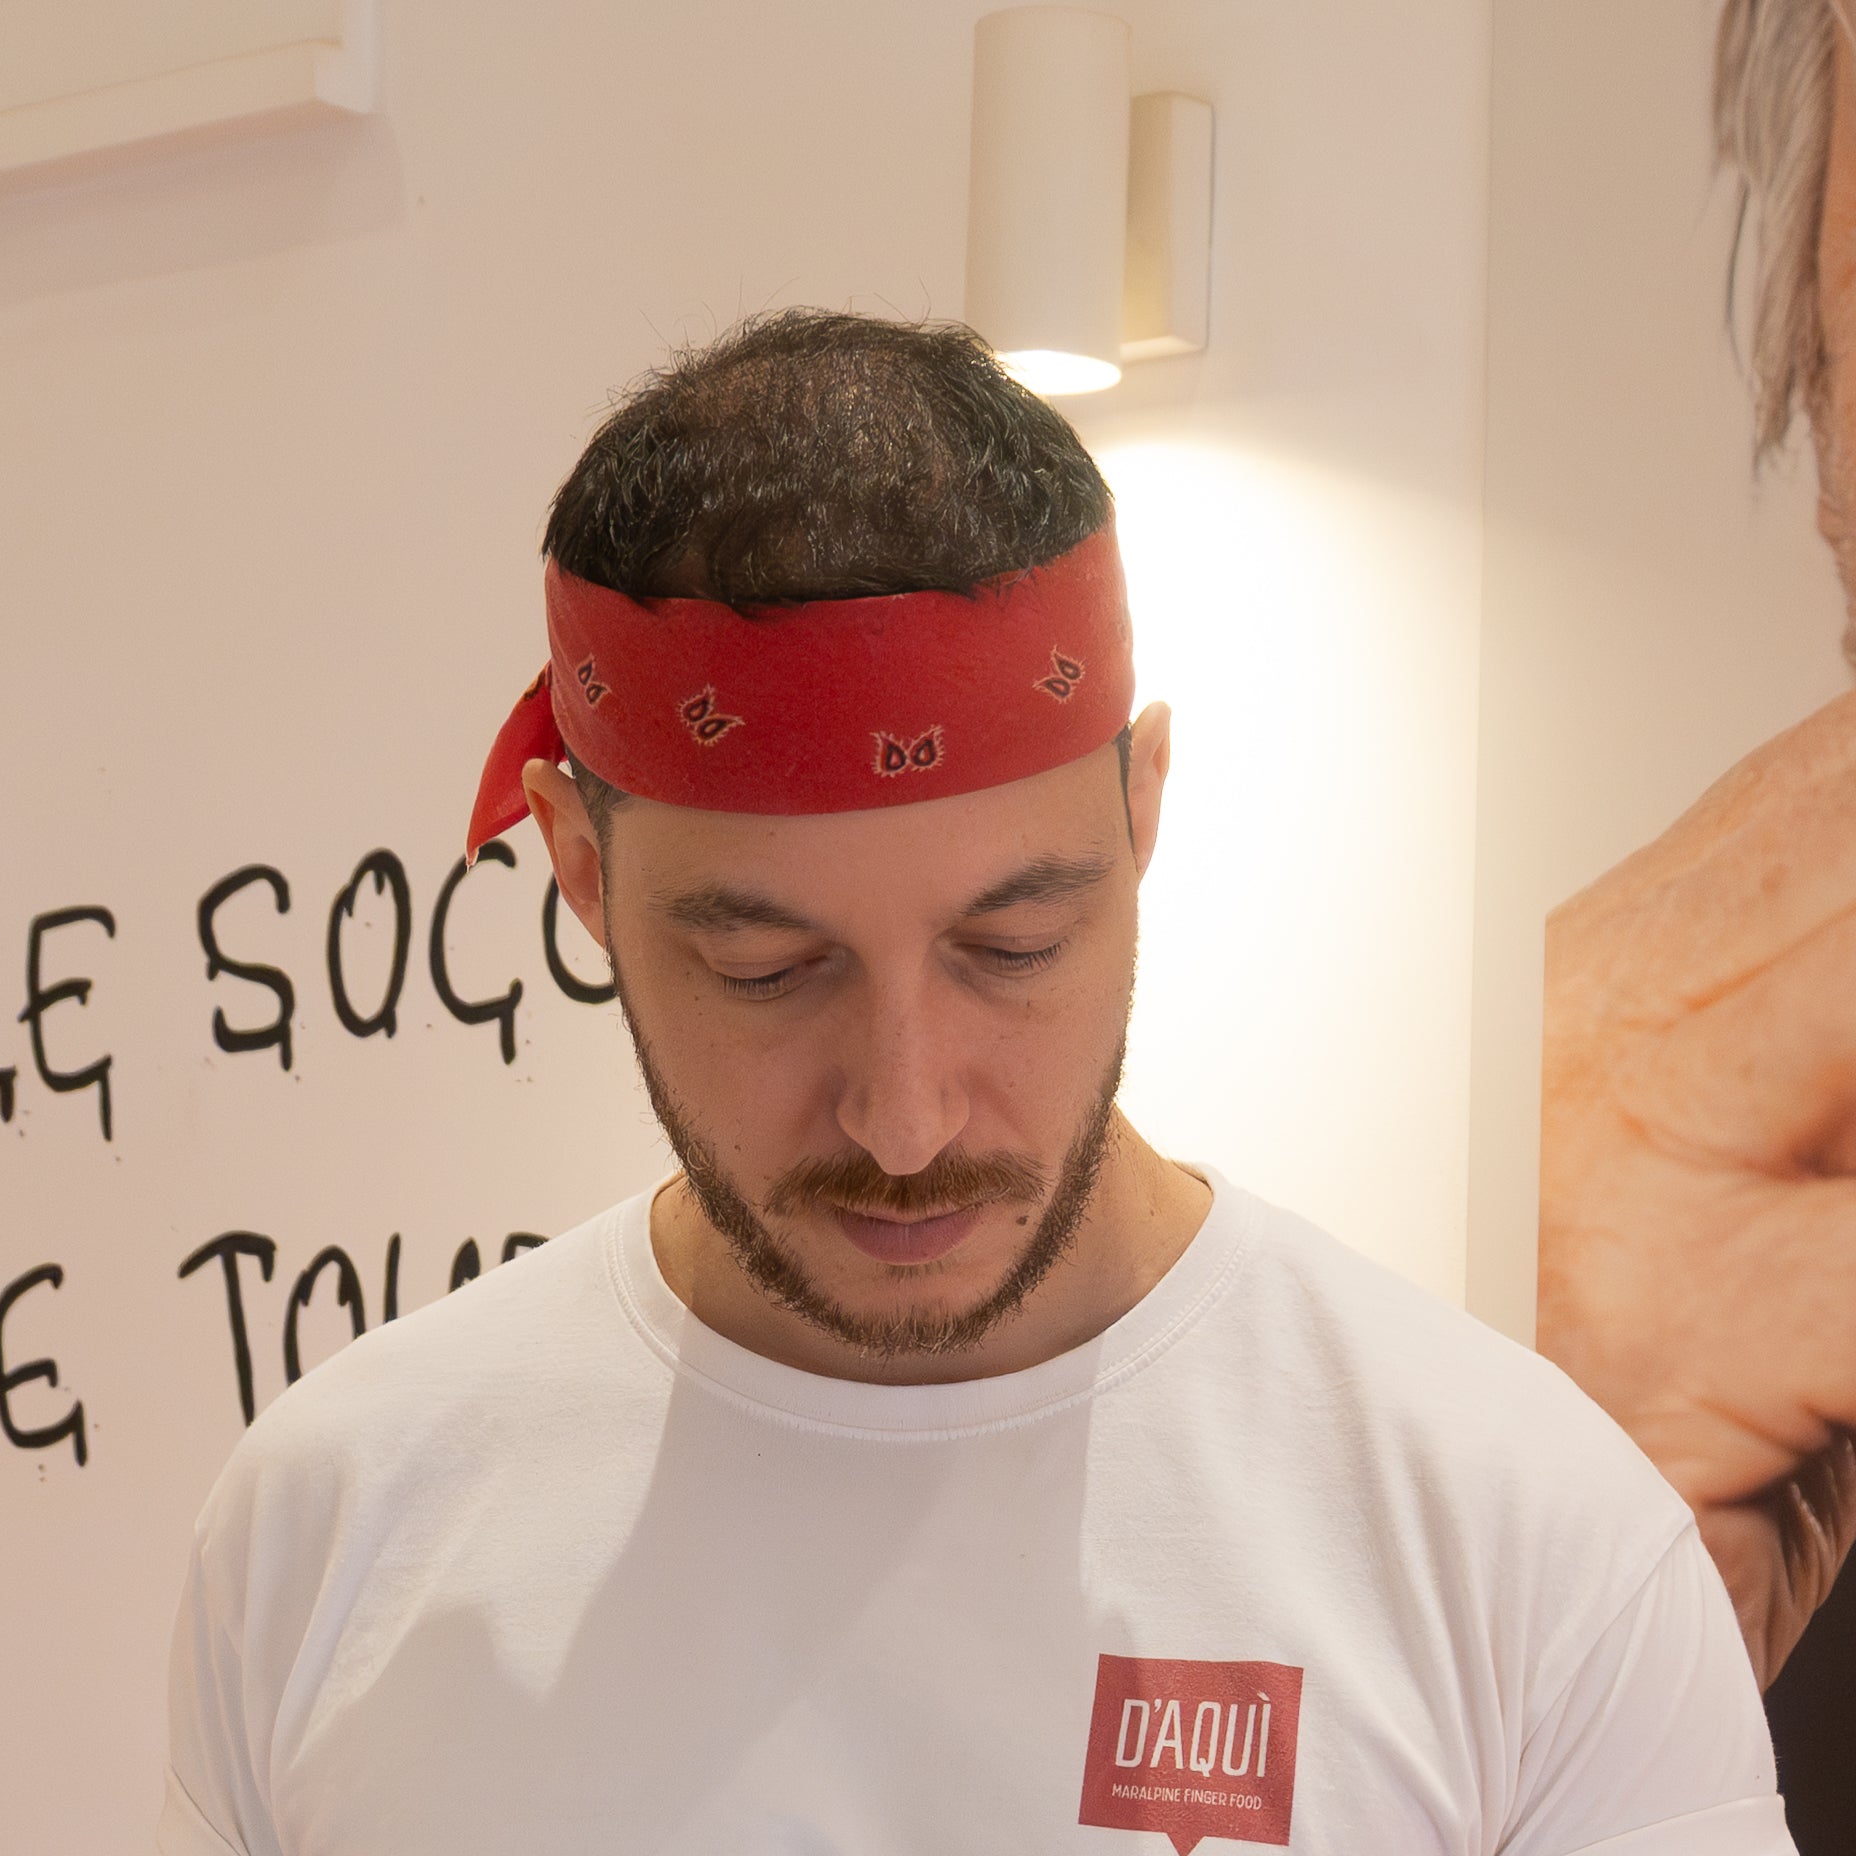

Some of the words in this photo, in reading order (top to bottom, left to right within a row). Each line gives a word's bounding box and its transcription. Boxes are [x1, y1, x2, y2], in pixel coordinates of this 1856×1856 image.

[1114, 1690, 1272, 1778] D'AQUÌ
[1111, 1783, 1181, 1803] MARALPINE
[1183, 1788, 1228, 1806] FINGER
[1229, 1793, 1263, 1810] FOOD
